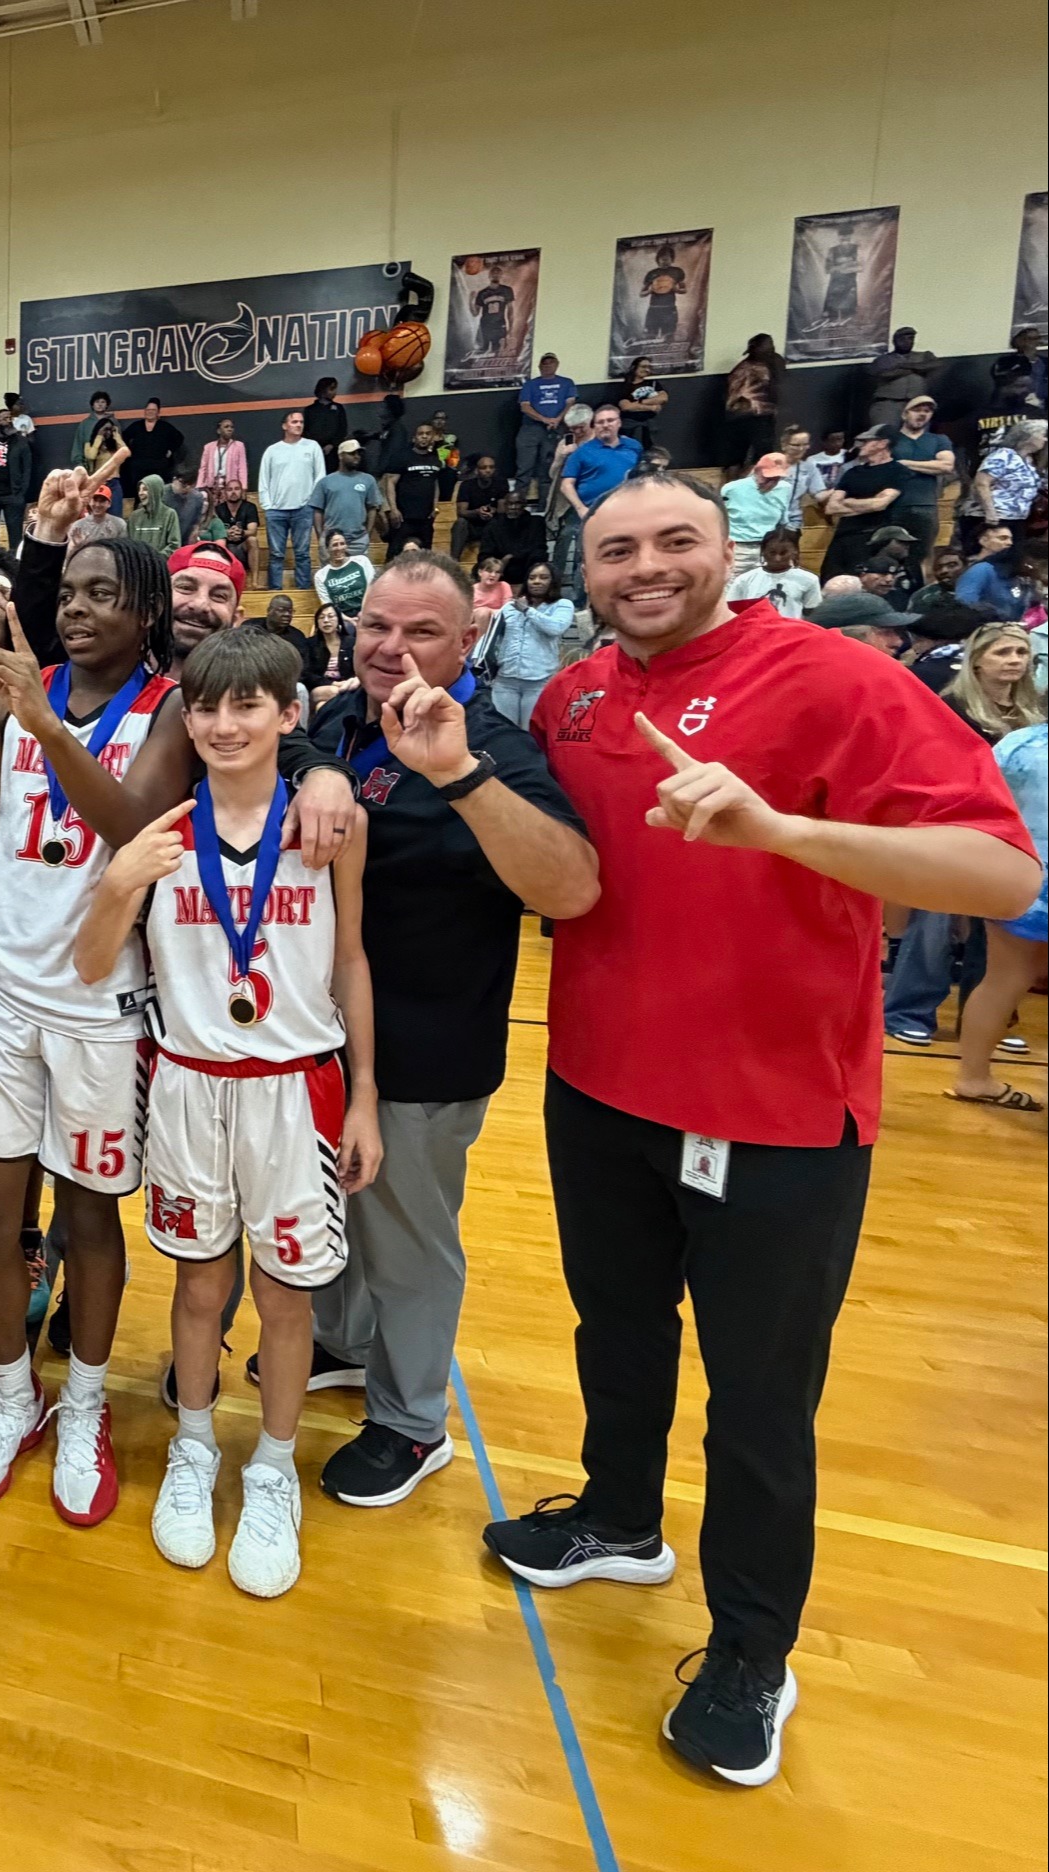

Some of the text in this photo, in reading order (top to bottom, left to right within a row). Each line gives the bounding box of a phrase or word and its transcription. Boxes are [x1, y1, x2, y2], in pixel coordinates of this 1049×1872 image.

[27, 322, 206, 384] STINGRAY
[15, 788, 97, 869] 15
[173, 885, 316, 926] MAPORT
[228, 938, 274, 1022] 5
[70, 1128, 126, 1179] 15
[274, 1215, 303, 1266] 5
